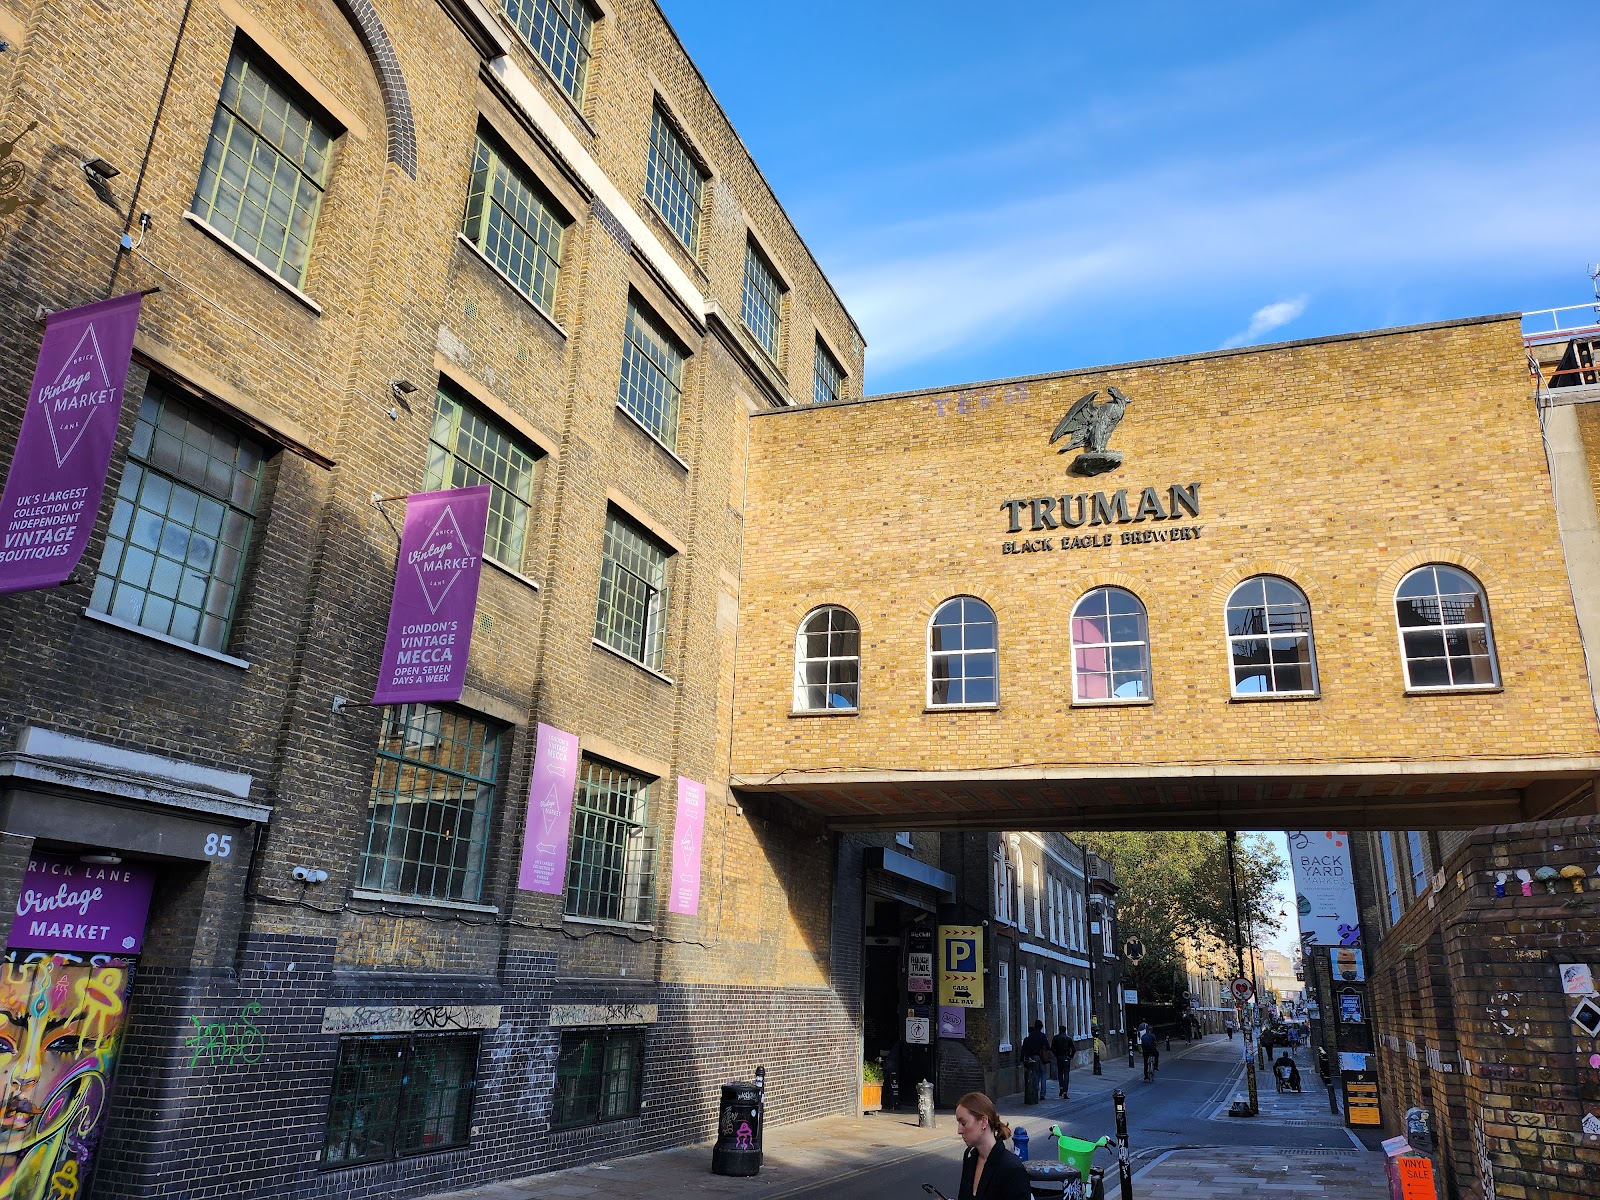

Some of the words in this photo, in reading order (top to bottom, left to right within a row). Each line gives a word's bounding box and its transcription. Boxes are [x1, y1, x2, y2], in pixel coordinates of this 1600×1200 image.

[73, 354, 95, 365] BRICK
[38, 370, 91, 404] Vintage
[54, 387, 117, 413] MARKET
[59, 421, 80, 431] LANE
[16, 493, 41, 507] UK'S
[41, 487, 89, 503] LARGEST
[13, 502, 70, 518] COLLECTION
[71, 500, 85, 511] OF
[1000, 481, 1202, 533] TRUMAN
[8, 512, 81, 531] INDEPENDENT
[4, 525, 77, 549] VINTAGE
[435, 529, 455, 537] BRICK
[1002, 537, 1054, 555] BLACK
[1061, 532, 1113, 550] EAGLE
[1121, 525, 1205, 545] BREWERY
[0, 544, 70, 564] BOUTIQUES
[408, 542, 453, 566] Vintage
[423, 556, 477, 573] MARKET
[402, 621, 458, 635] LONDON'S
[400, 633, 456, 649] VINTAGE
[396, 647, 453, 665] MECCA
[392, 675, 414, 686] DAYS
[416, 675, 423, 684] A
[425, 673, 450, 683] WEEK
[394, 667, 420, 677] OPEN
[421, 664, 452, 675] SEVEN
[547, 748, 568, 762] MECCA
[203, 833, 233, 858] 85
[1301, 855, 1343, 866] BACK
[28, 860, 74, 877] RICK
[85, 867, 132, 883] LANE
[1301, 867, 1344, 877] YARD
[16, 882, 104, 916] Vintage
[29, 920, 111, 941] MARKET
[951, 941, 971, 970] P
[1403, 1159, 1427, 1169] VINYL
[1407, 1170, 1430, 1179] SALE
